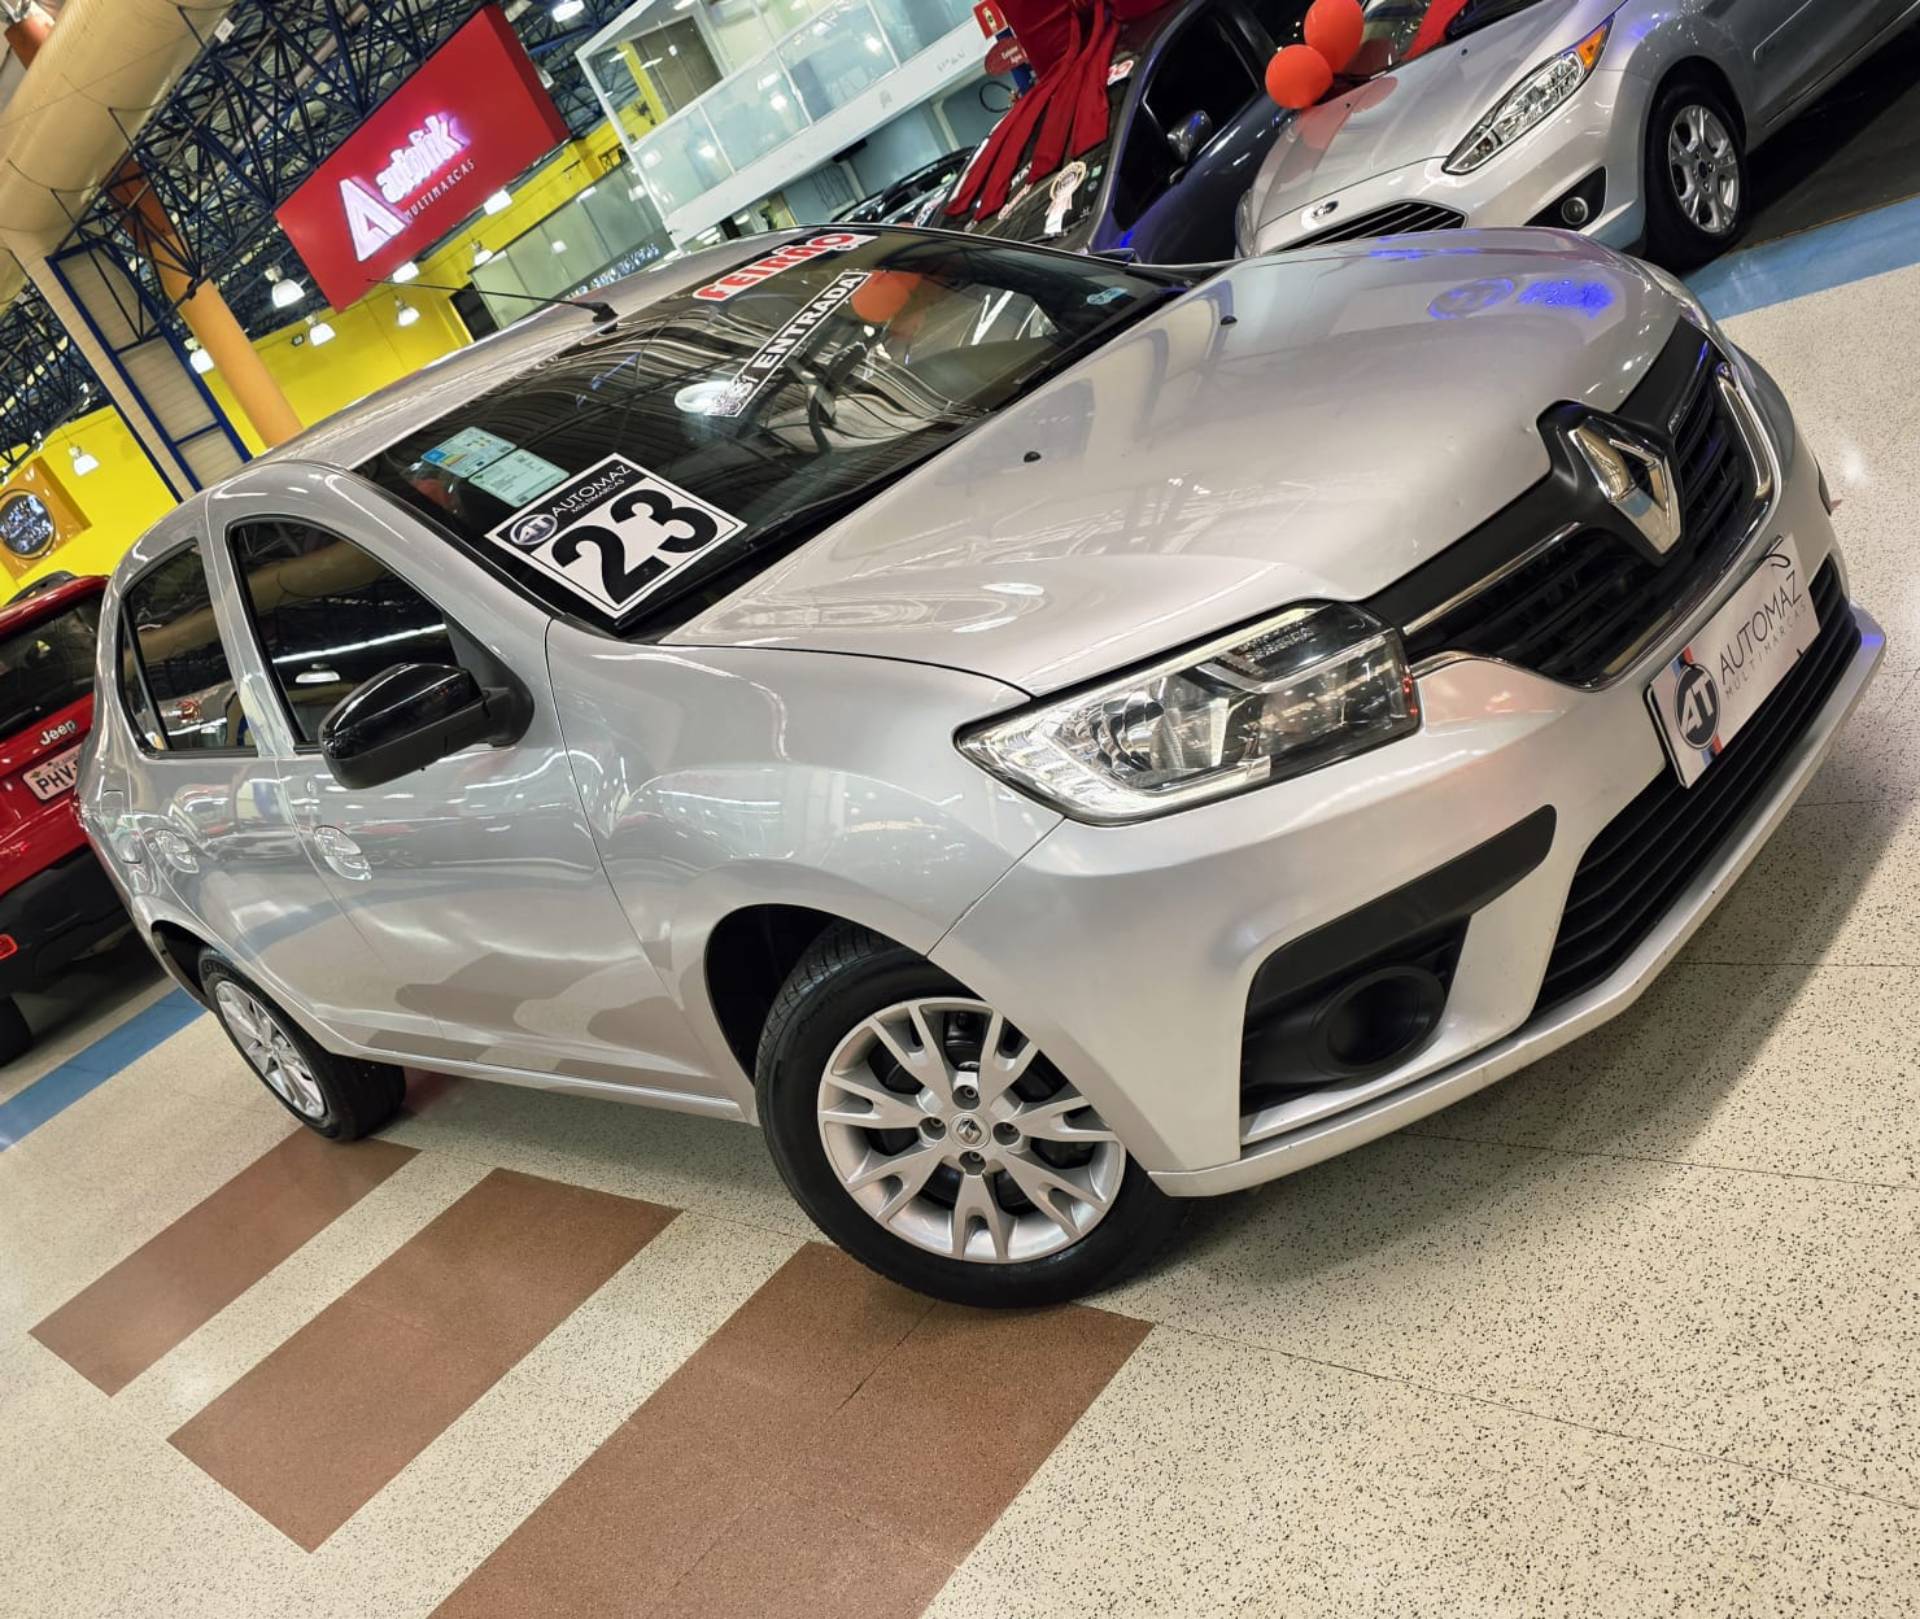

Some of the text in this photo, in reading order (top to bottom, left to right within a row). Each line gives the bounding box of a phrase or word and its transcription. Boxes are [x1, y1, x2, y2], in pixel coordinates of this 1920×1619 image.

[404, 159, 475, 220] MULTIMARCAS
[751, 275, 864, 369] ENTRADA
[551, 463, 633, 518] AUTOMAZ
[570, 478, 626, 514] MULTIMARCAS
[551, 489, 718, 604] 23
[1719, 569, 1803, 685] AUTOMAZ
[1724, 603, 1809, 700] MULTIMARCAS
[40, 720, 77, 746] Jeep
